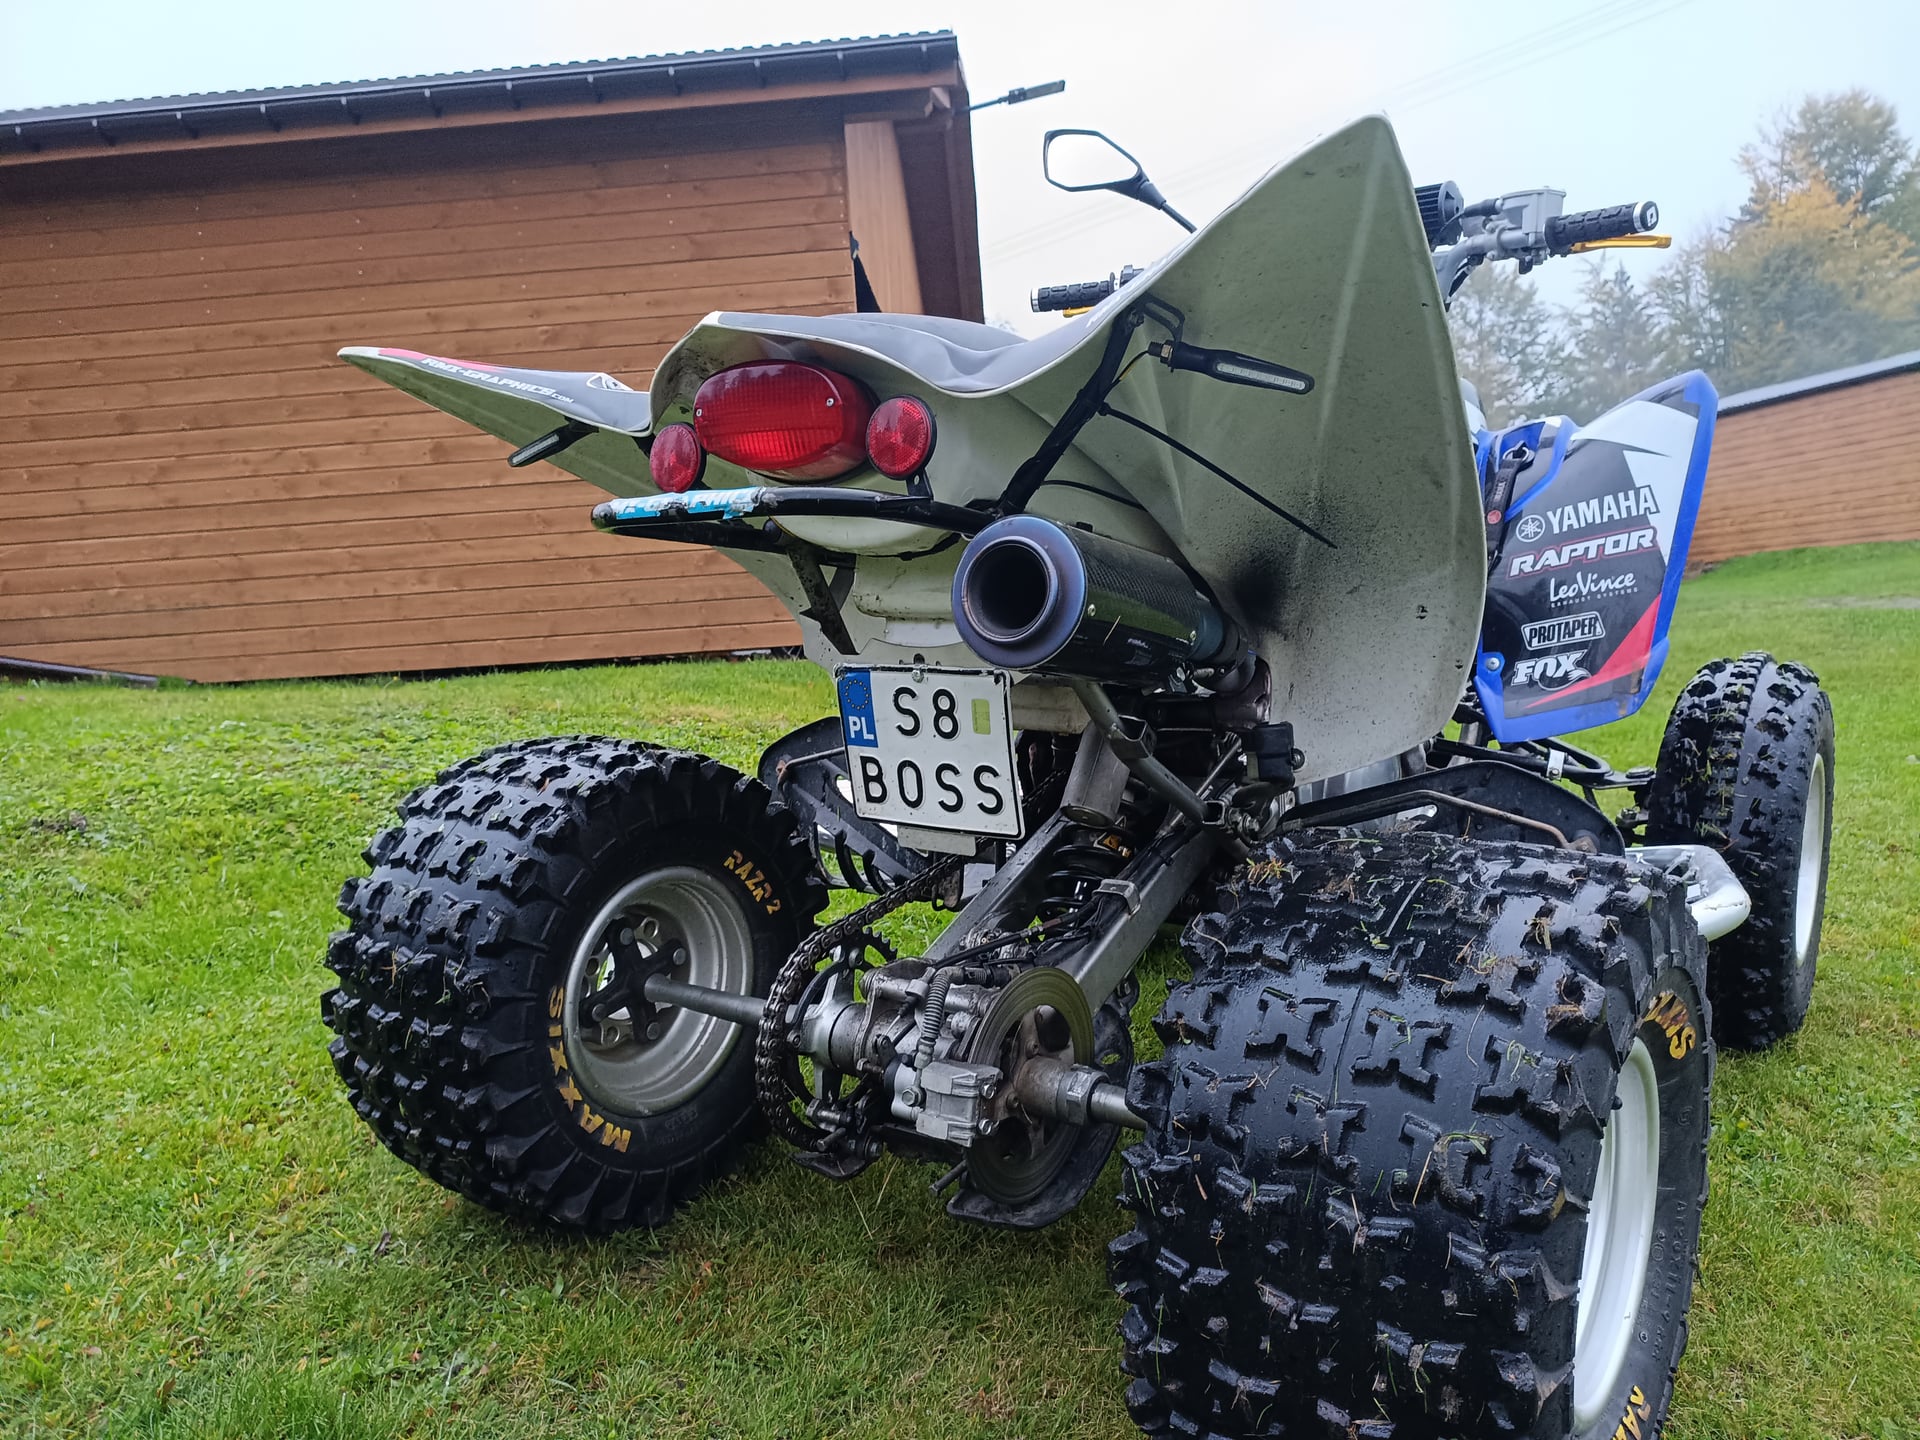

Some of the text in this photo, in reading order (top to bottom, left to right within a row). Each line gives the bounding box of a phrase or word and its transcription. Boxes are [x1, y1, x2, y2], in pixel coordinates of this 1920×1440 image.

[1547, 486, 1658, 534] YAMAHA
[1509, 528, 1655, 577] RAPTOR
[1550, 571, 1636, 602] LeoVince
[1528, 616, 1600, 645] PROTAPER
[1511, 649, 1591, 689] FOX
[848, 716, 875, 741] PL
[893, 686, 959, 740] S8
[766, 898, 782, 915] 2
[549, 986, 632, 1153] MAXXIS
